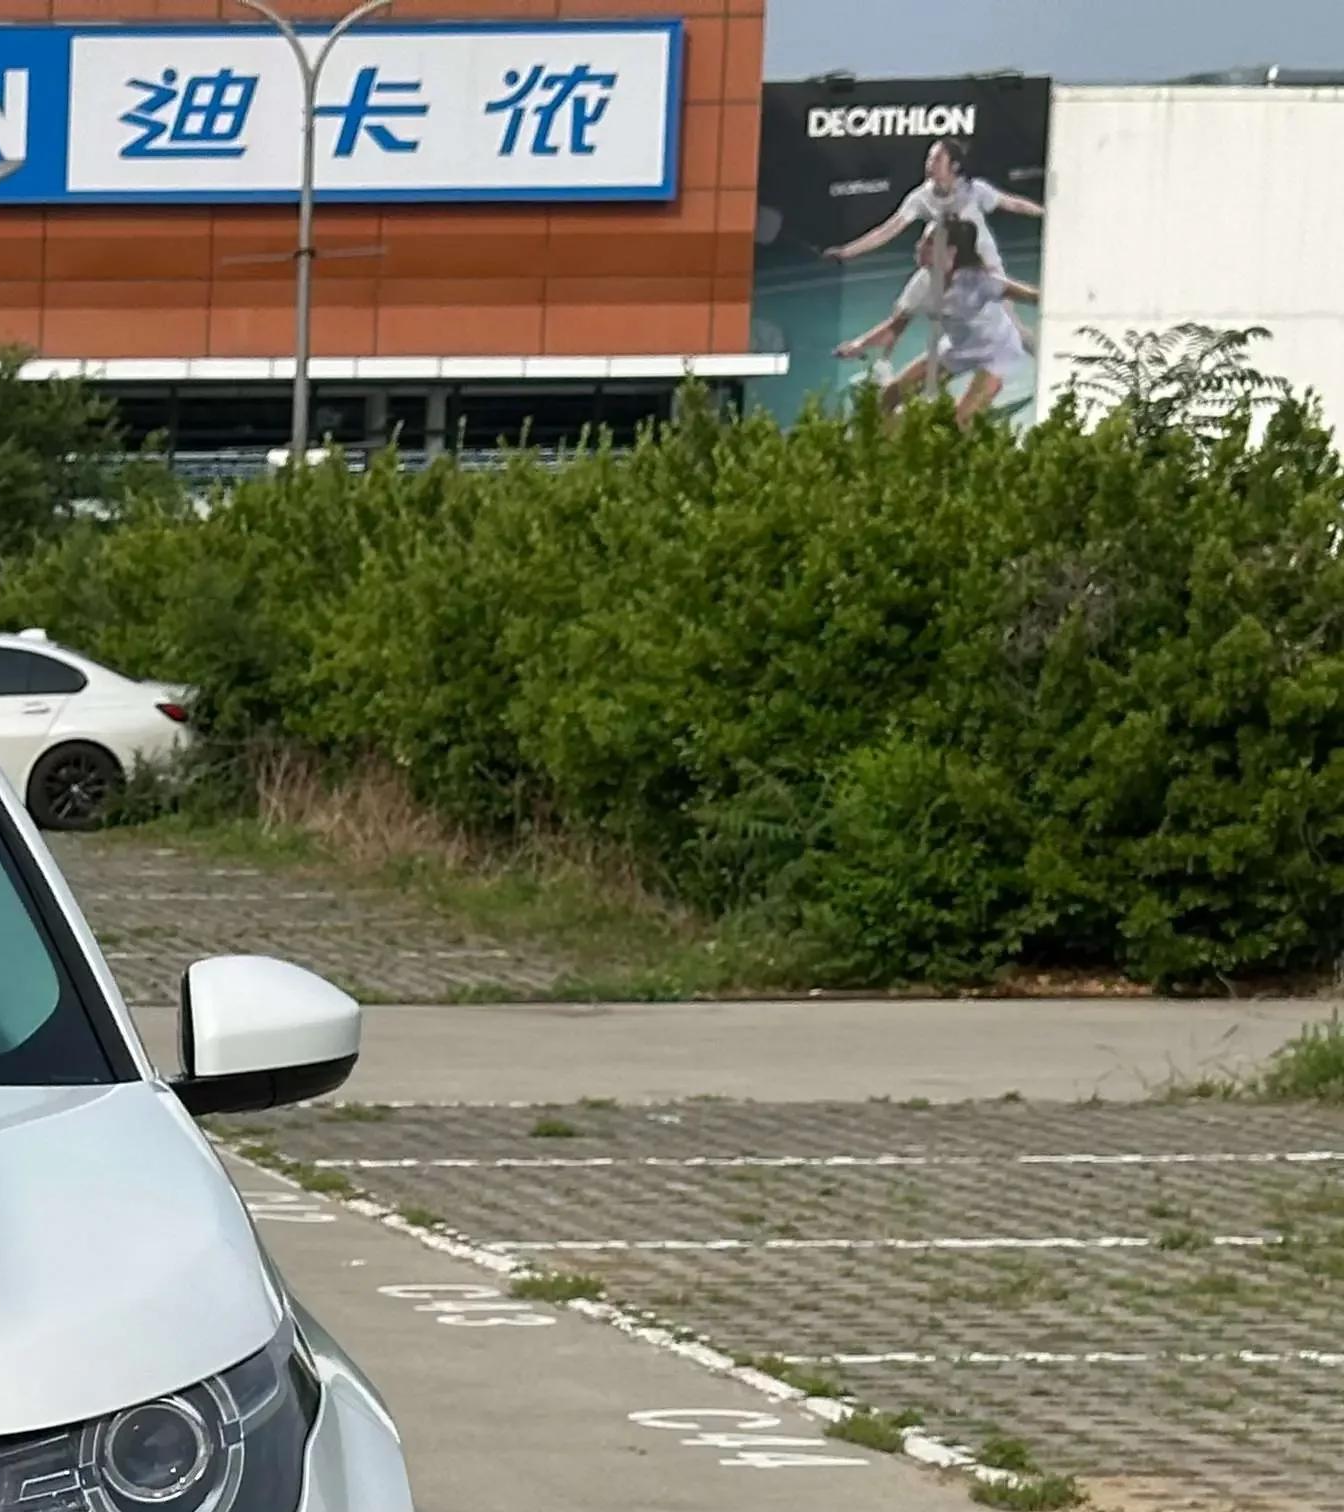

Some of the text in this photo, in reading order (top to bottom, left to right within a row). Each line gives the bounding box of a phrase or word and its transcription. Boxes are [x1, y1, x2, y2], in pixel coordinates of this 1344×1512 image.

[118, 64, 618, 158] 迪卡侬
[808, 104, 976, 138] DECATHLON
